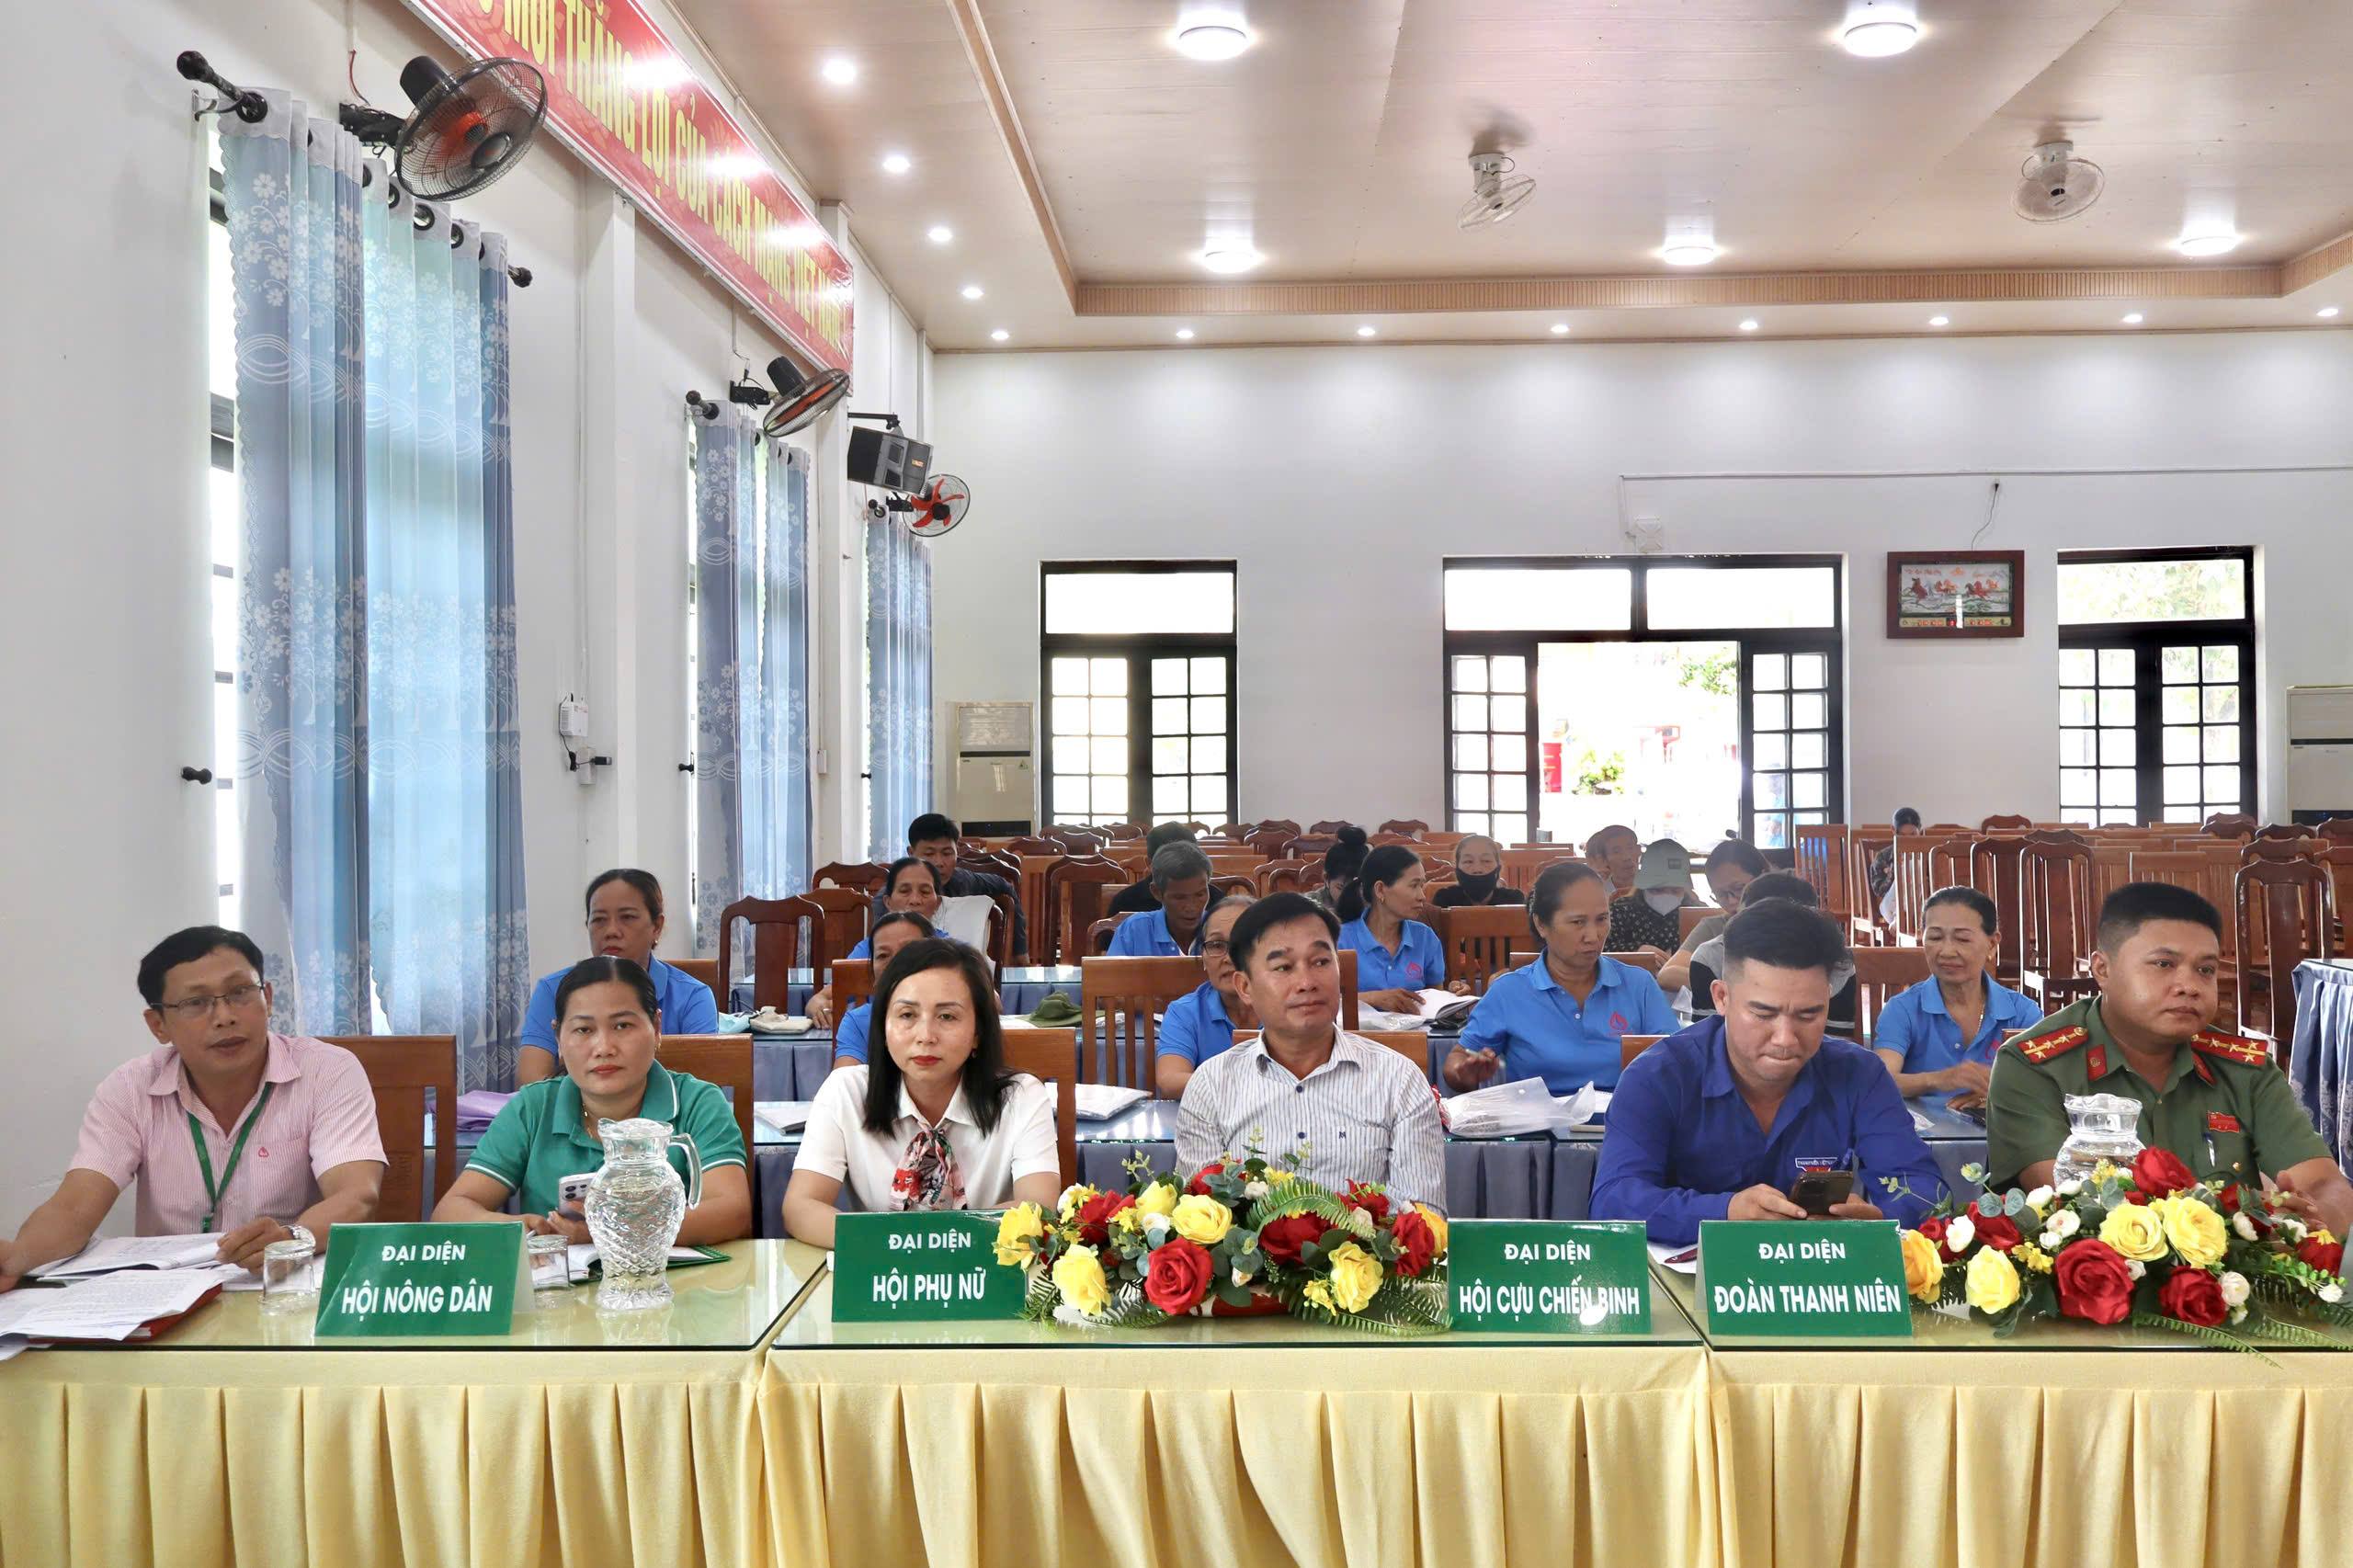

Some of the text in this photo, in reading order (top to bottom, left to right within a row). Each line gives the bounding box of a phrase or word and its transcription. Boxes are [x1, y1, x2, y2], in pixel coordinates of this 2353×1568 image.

[676, 93, 709, 224] CỦA
[381, 1240, 466, 1266] ĐẠI DIỆN
[888, 1228, 972, 1254] ĐẠI DIỆN
[1504, 1239, 1591, 1265] ĐẠI DIỆN
[1758, 1239, 1847, 1265] ĐẠI DIỆN
[341, 1278, 493, 1322] HỘI NÔNG DÂN
[872, 1267, 986, 1309] HỘI PHỤ NỮ
[1459, 1274, 1641, 1322] HỘI CỰU CHIẾN BINH
[1713, 1277, 1902, 1313] ĐOÀN THANH NIÊN
